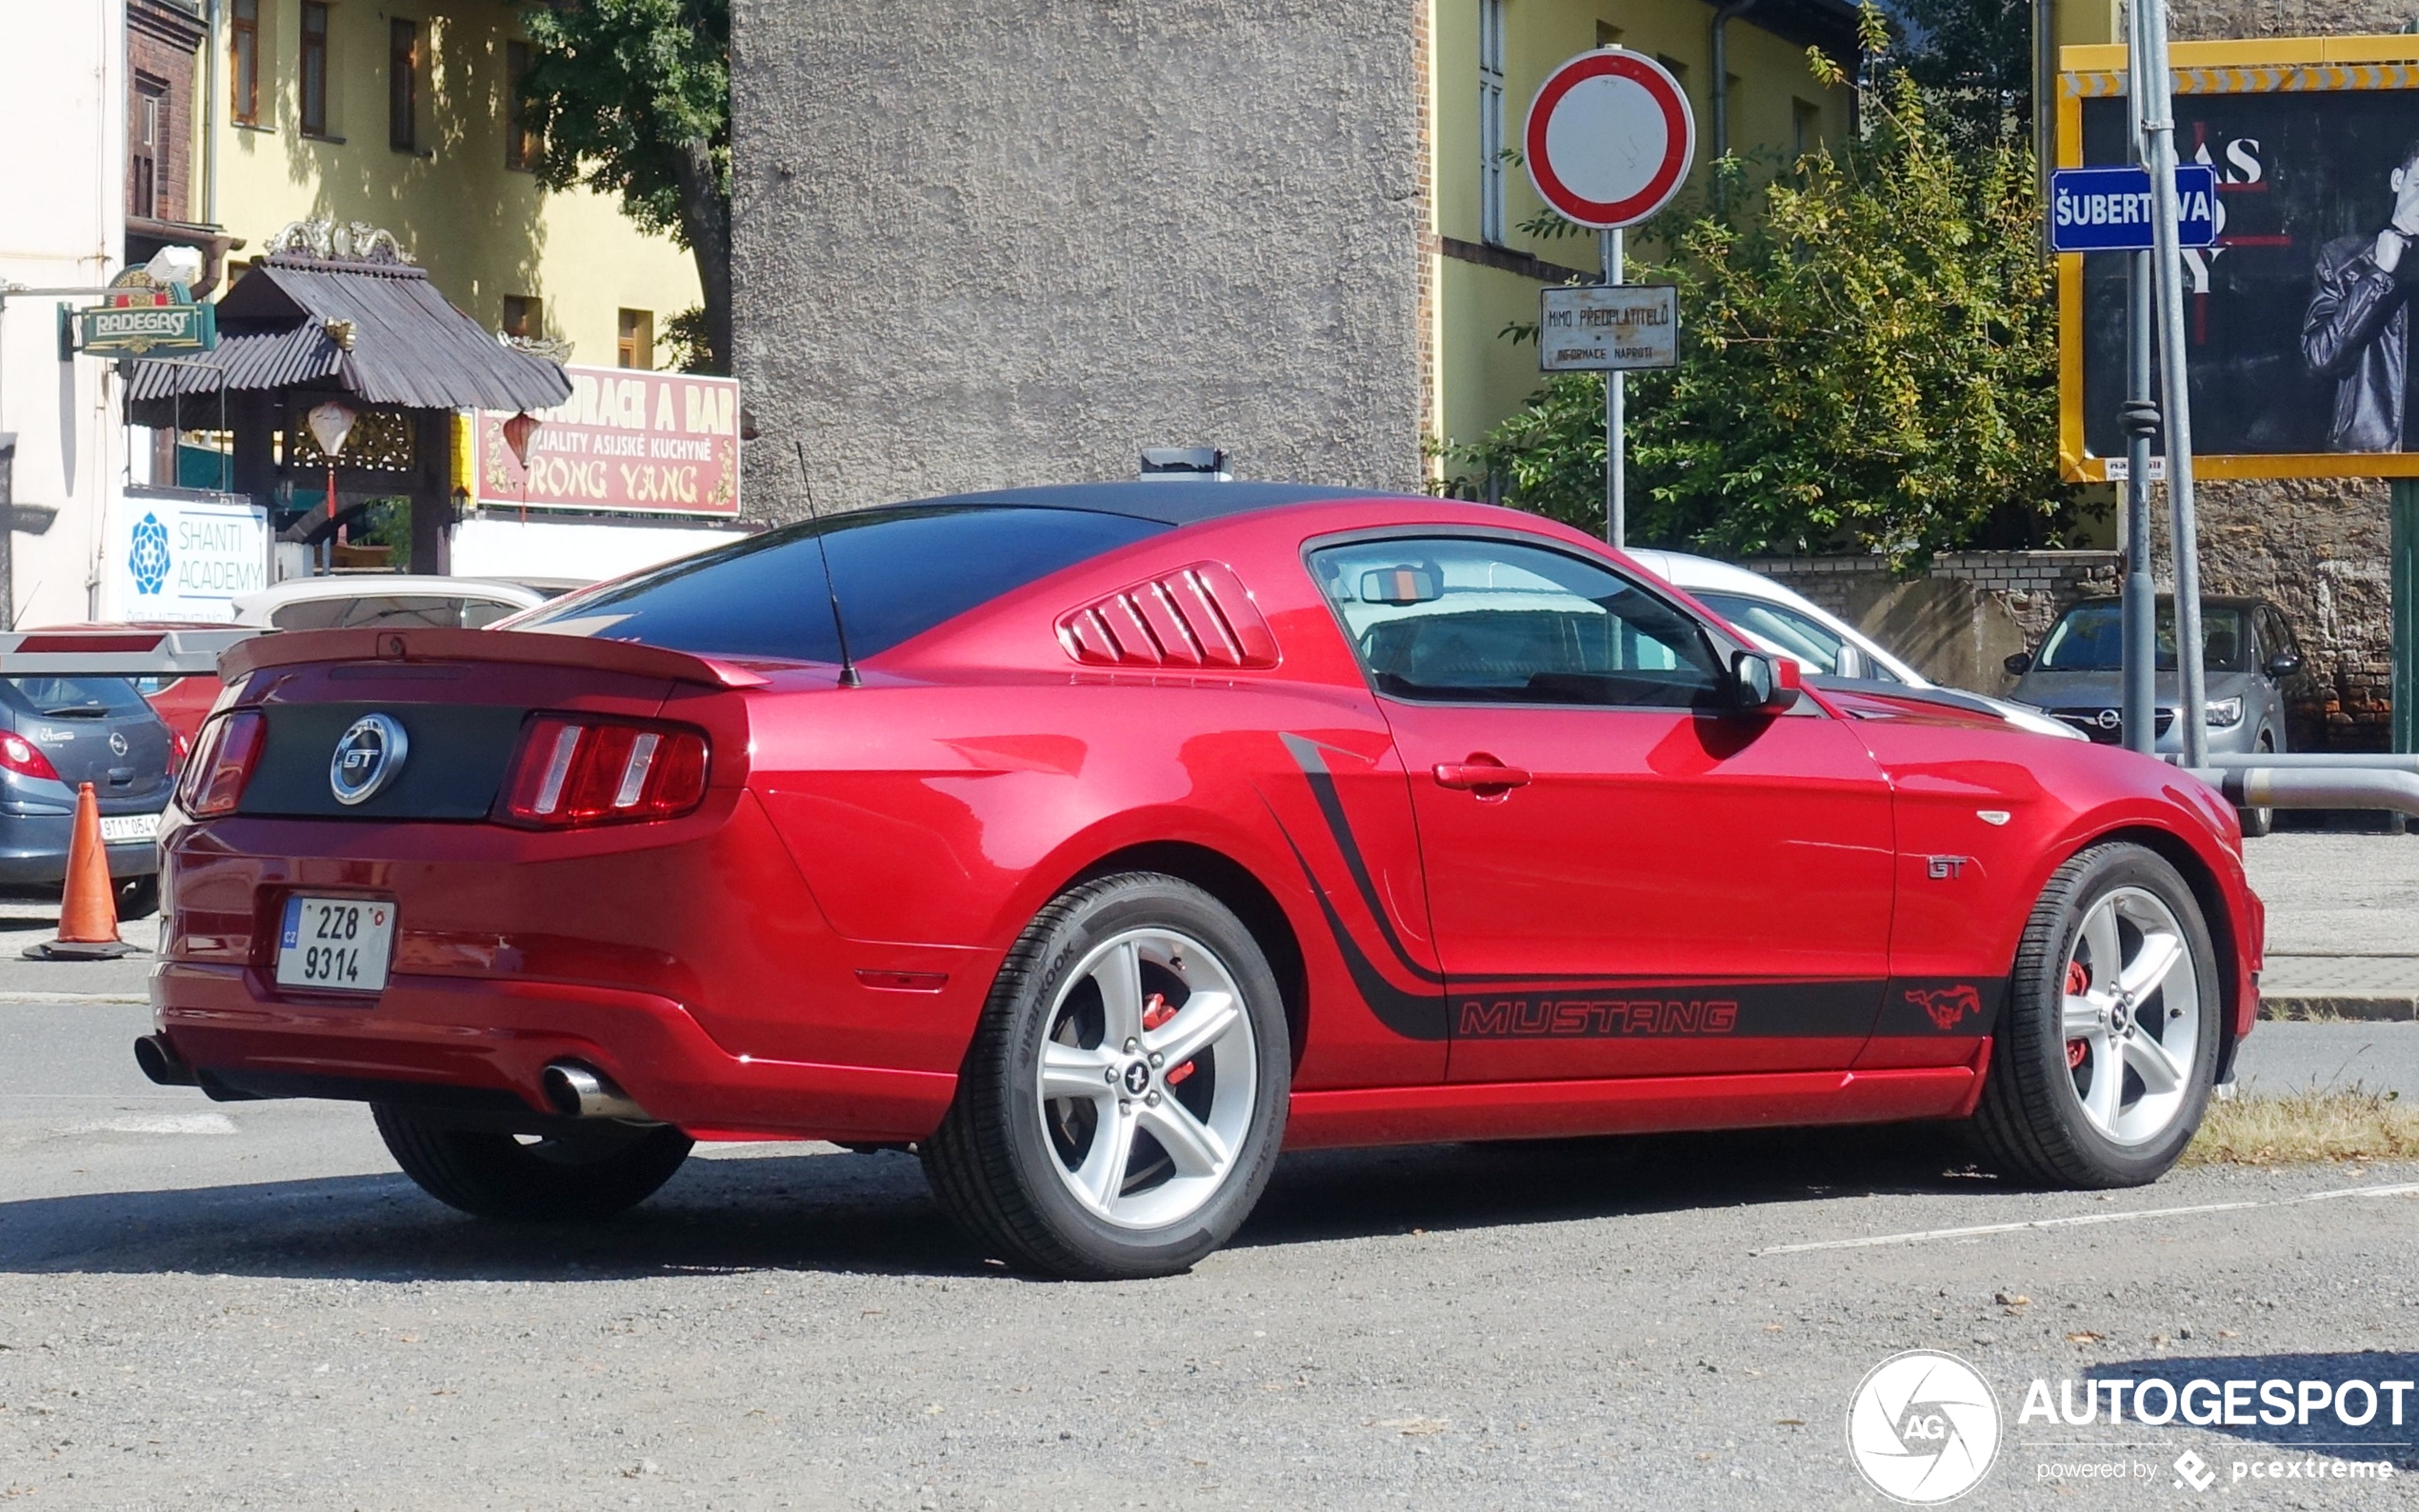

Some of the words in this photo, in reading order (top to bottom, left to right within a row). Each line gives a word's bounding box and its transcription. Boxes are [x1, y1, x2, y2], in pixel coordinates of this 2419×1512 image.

[2056, 188, 2211, 226] ŠUBERTVA
[96, 312, 190, 336] RADEGAST
[1549, 309, 1572, 327] MIMO
[1580, 304, 1669, 326] PŘEDPLATITELŮ
[1557, 348, 1607, 361] INFORMACE
[1614, 347, 1652, 360] NAPROTI
[654, 383, 675, 431] A
[685, 384, 734, 436] BAR
[592, 432, 645, 457] ASIJSKÉ
[650, 438, 711, 462] KUCHYNĚ
[620, 463, 699, 504] YANG
[178, 521, 242, 552] SHANTI
[178, 560, 263, 590] ACADEMY
[344, 748, 379, 768] GT
[1929, 854, 1967, 879] GT
[284, 931, 296, 944] CZ
[316, 905, 359, 940] 2Z8
[305, 946, 359, 982] 9314
[1459, 1001, 1738, 1034] MUSTANG
